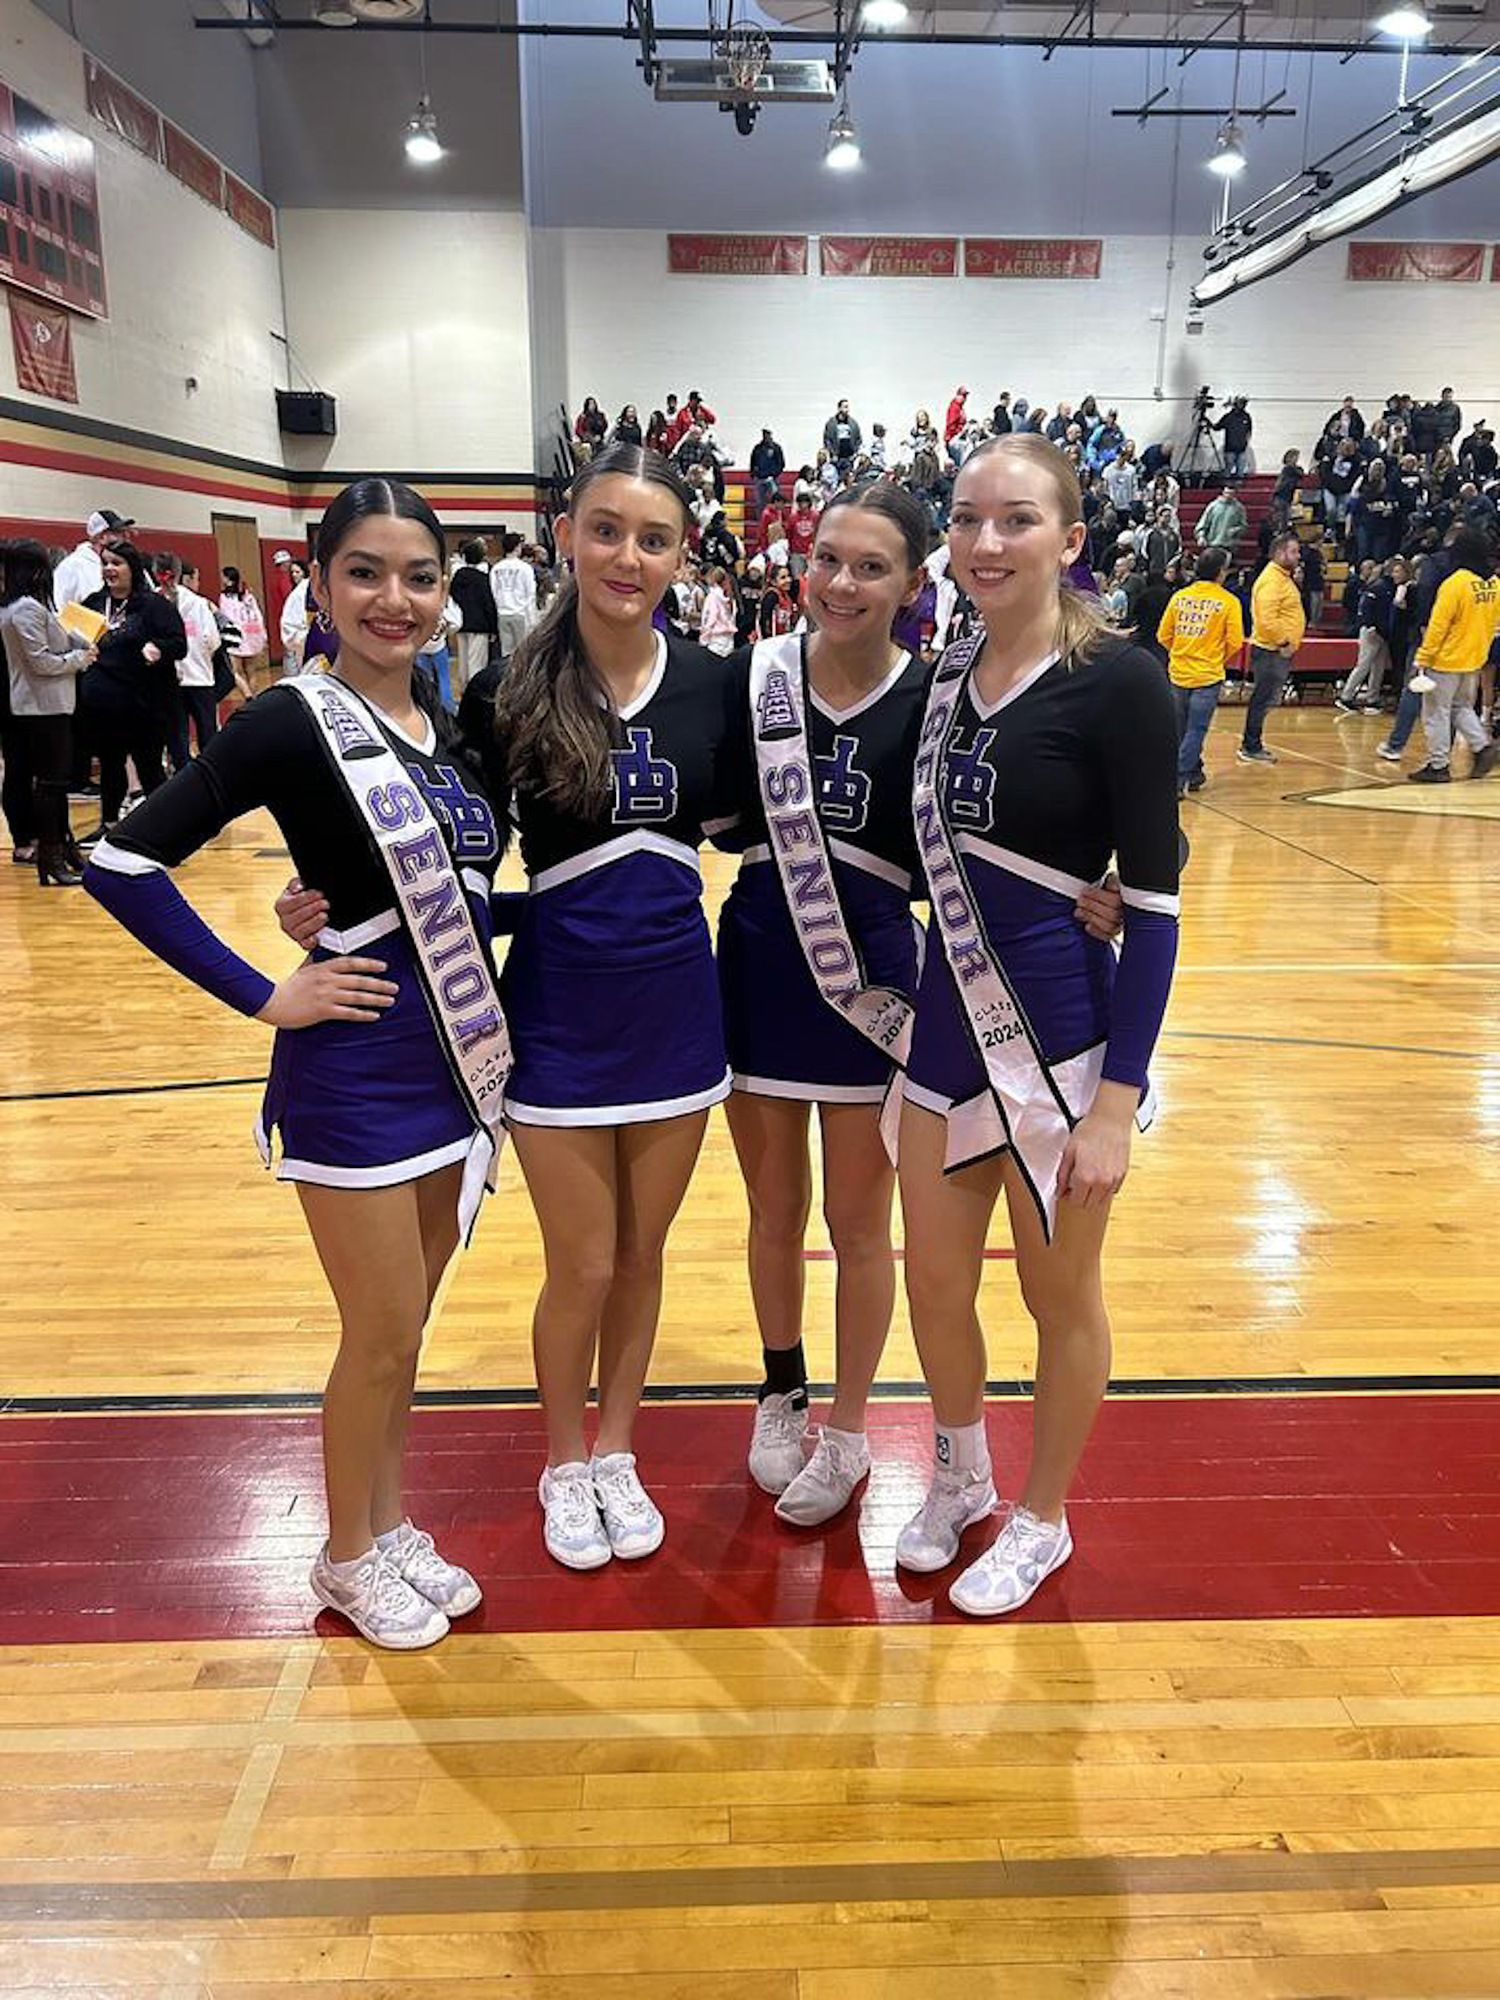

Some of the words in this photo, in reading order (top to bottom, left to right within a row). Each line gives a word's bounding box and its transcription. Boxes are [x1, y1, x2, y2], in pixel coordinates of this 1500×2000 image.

[1175, 597, 1222, 613] ATHLETIC
[1178, 611, 1209, 623] EVENT
[1175, 624, 1204, 636] STAFF
[763, 676, 793, 728] CHEER
[323, 693, 373, 750] CHEER
[367, 781, 503, 1057] SENIOR
[974, 1001, 1012, 1021] CLASS
[880, 1007, 911, 1046] 2024
[982, 1020, 1023, 1048] 2024
